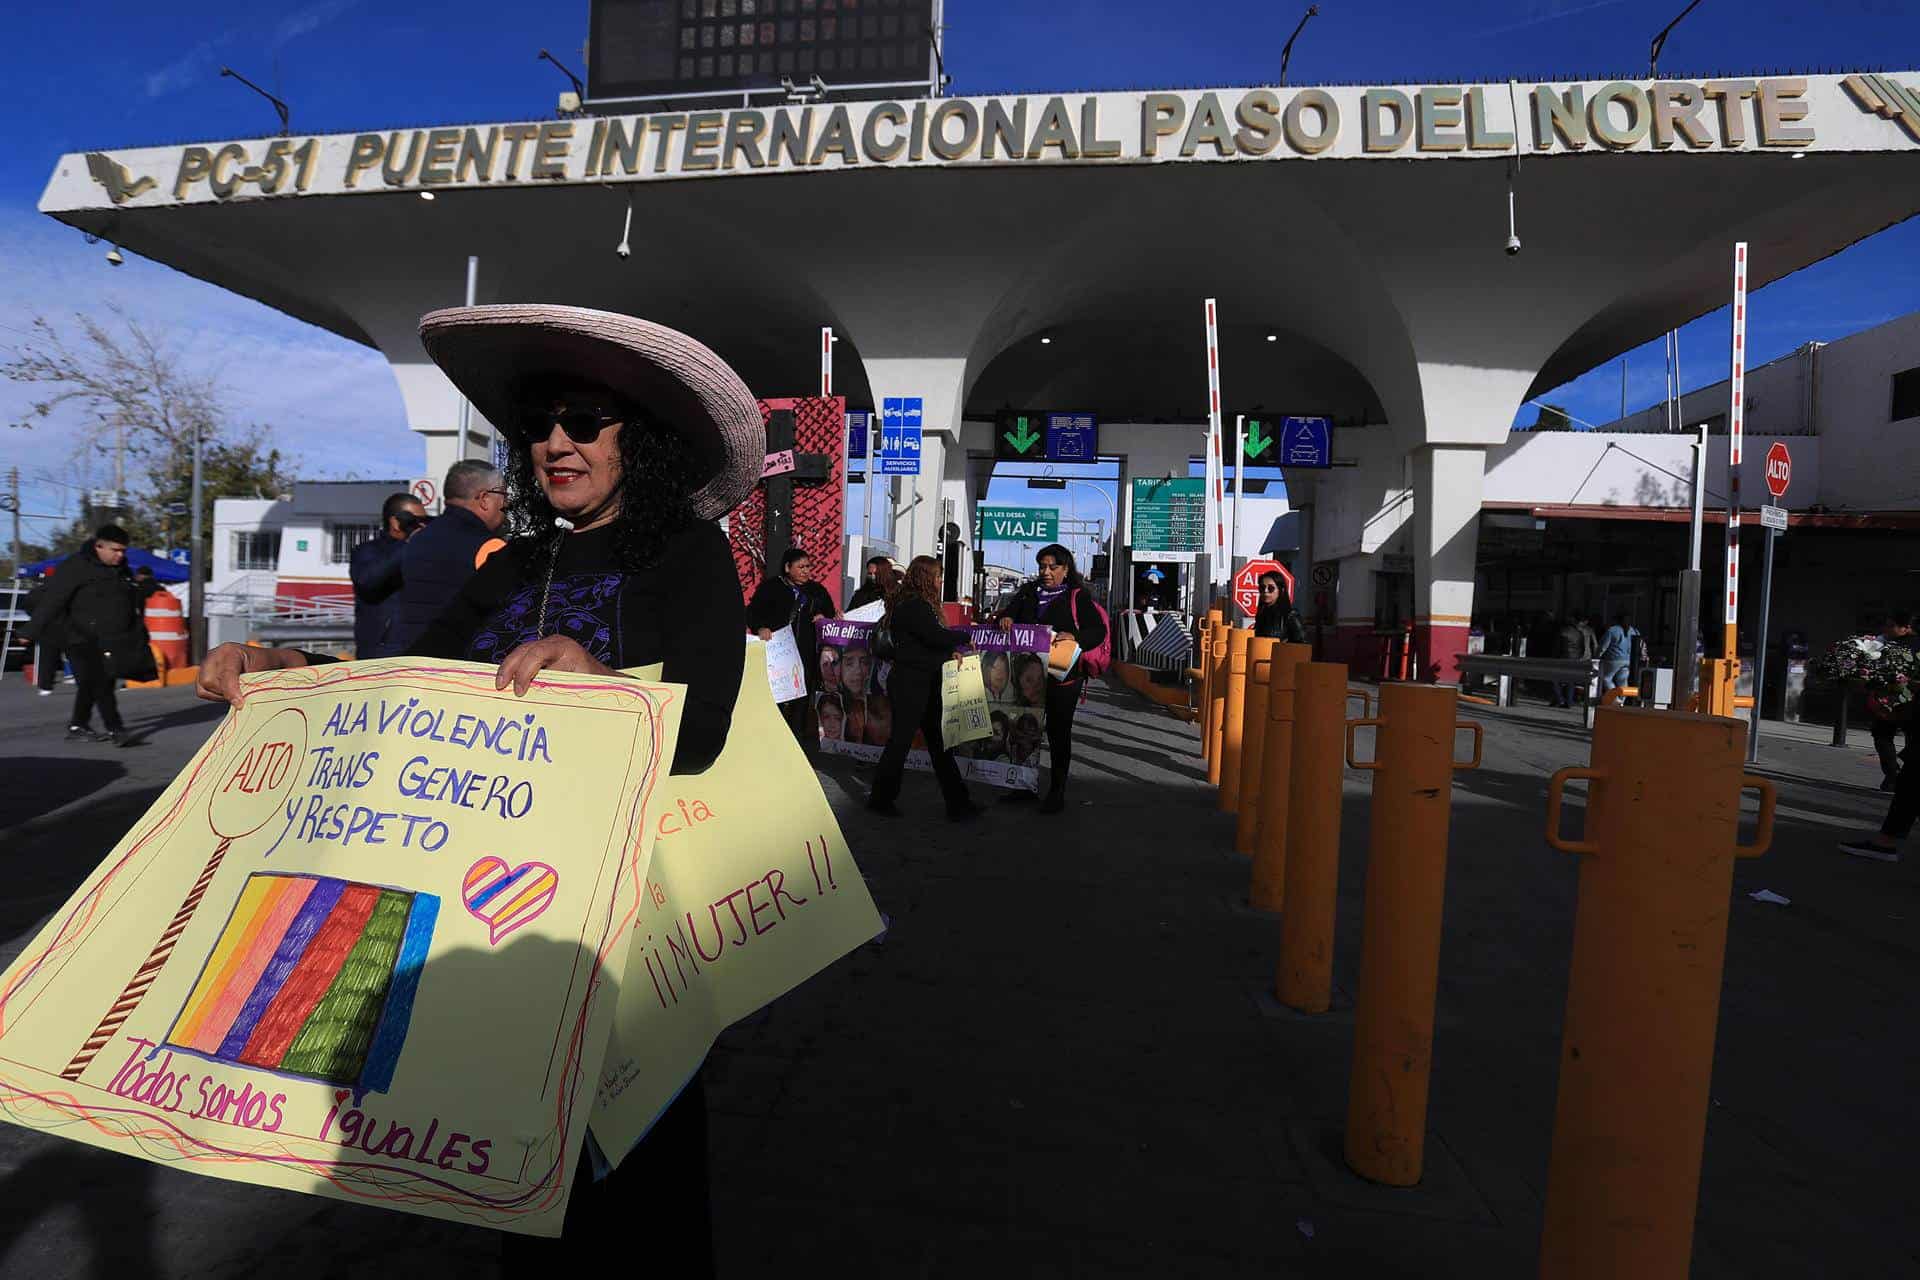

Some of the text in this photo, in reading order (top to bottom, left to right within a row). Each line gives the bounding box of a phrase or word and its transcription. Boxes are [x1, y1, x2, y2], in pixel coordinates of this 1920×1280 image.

[172, 79, 1816, 200] PC-51 PUENTE INTERNACIONAL PASO DEL NORTE
[1137, 479, 1172, 487] TARIS
[1767, 458, 1788, 481] ALTO
[993, 521, 1047, 537] VIAJE
[1242, 592, 1260, 607] ST
[841, 624, 865, 640] ellas
[1014, 629, 1035, 647] YA!
[223, 741, 295, 794] ALTO
[307, 746, 533, 820] TRANS GENERO
[656, 799, 716, 840] cia
[106, 1036, 191, 1112] Todos
